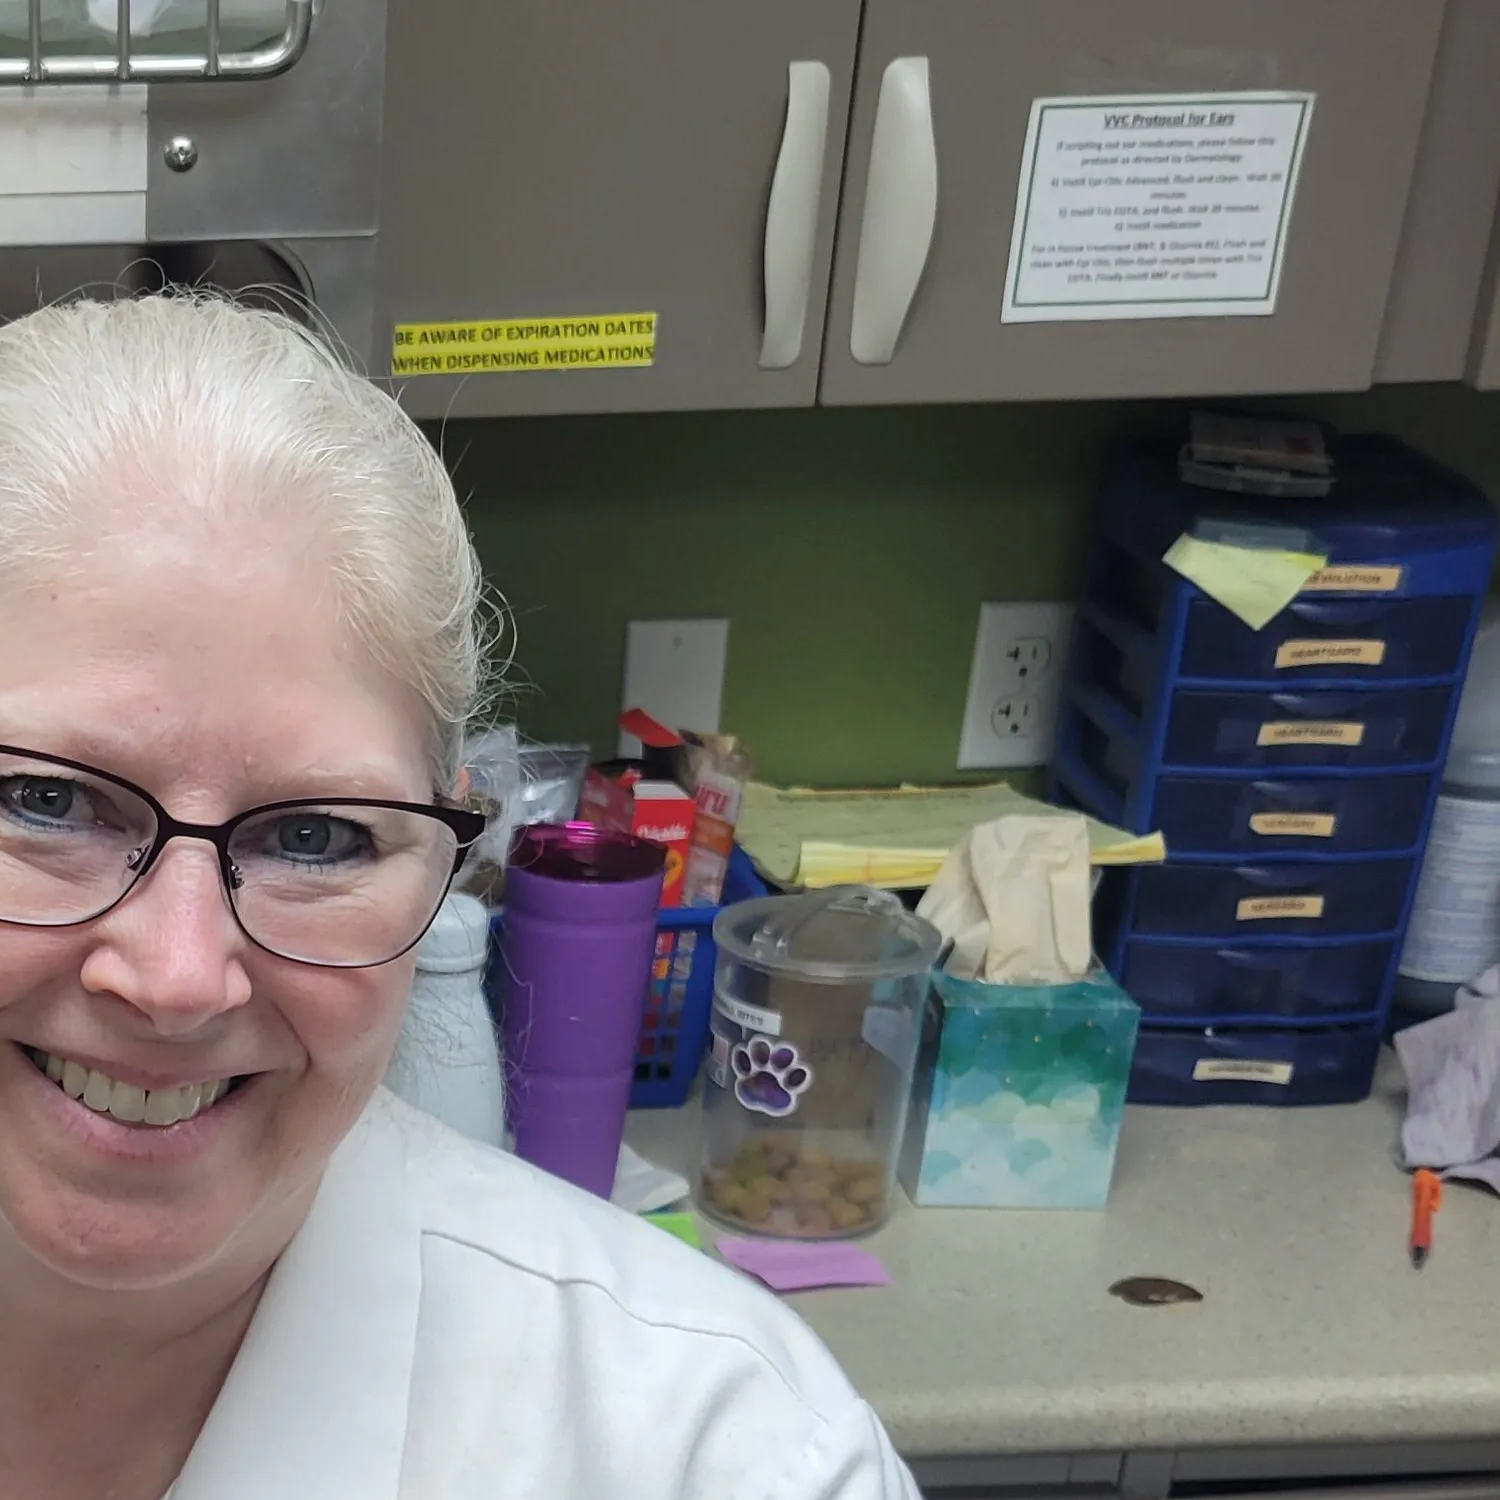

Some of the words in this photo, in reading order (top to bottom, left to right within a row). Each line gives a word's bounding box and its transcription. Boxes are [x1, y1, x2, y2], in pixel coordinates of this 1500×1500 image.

[1104, 113, 1131, 128] VVC
[1131, 112, 1185, 128] Protocol
[1187, 111, 1208, 127] for
[1208, 111, 1236, 127] Ears
[394, 331, 414, 347] BE
[419, 329, 477, 346] AWARE
[481, 327, 503, 343] OF
[506, 322, 600, 342] EXPIRATION
[604, 320, 654, 336] DATES
[393, 355, 442, 373] WHEN
[446, 350, 540, 370] DISPENSING
[543, 346, 655, 365] MEDICATIONS
